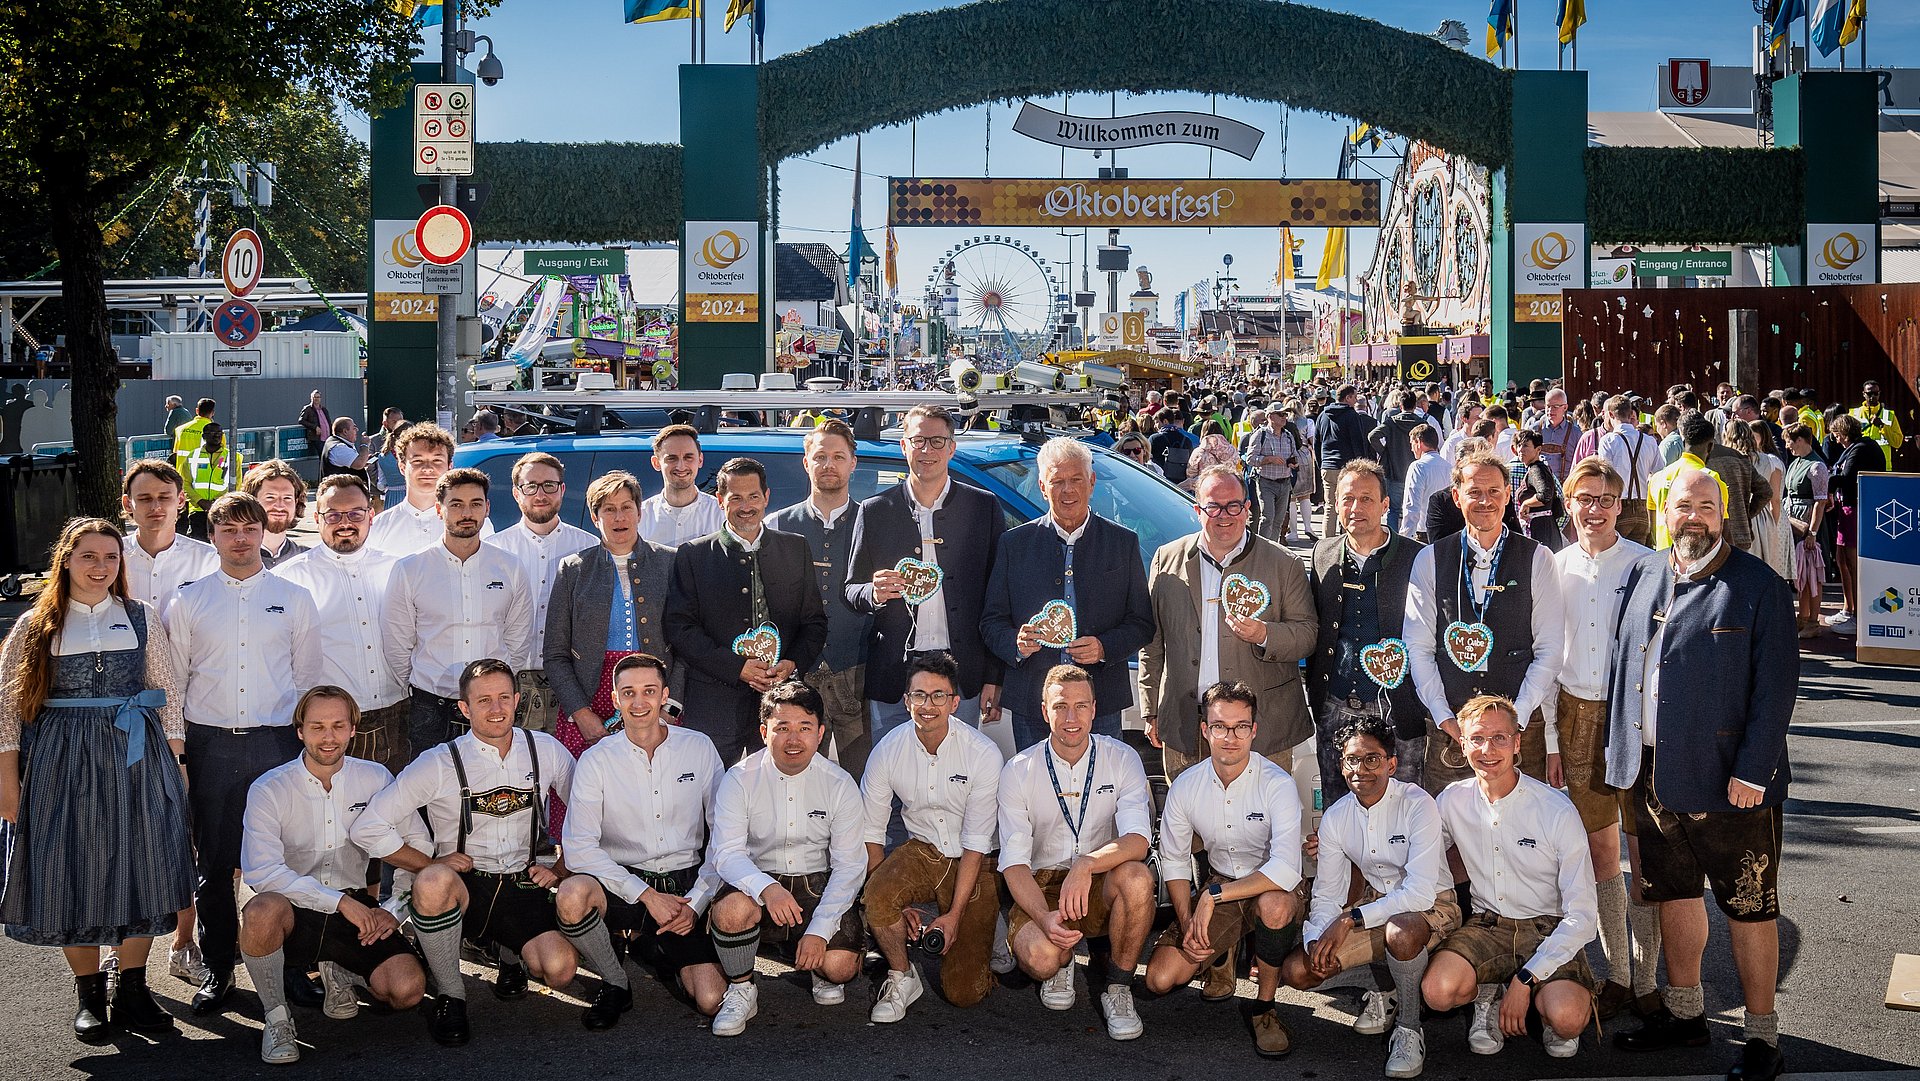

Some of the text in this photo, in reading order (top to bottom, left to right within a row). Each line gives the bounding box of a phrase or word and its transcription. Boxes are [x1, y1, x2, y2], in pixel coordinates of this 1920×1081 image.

[1057, 120, 1220, 143] Willkommen zum
[1038, 183, 1235, 223] Oktoberfest
[234, 248, 253, 279] 10
[537, 258, 609, 270] Ausgang / Exit
[1639, 259, 1728, 271] Eingang / Entrance
[427, 268, 449, 276] Fahrzeug
[697, 271, 745, 281] Oktoberfest
[1526, 272, 1572, 282] Oktoberfest
[1818, 272, 1863, 282] Oktoberfest
[1232, 296, 1282, 304] vinzenzmur
[390, 299, 436, 315] 2024
[701, 300, 746, 316] 2024
[1529, 300, 1562, 316] 202
[216, 359, 258, 369] Rettungsweg
[1146, 355, 1194, 373] Information
[904, 570, 914, 579] M
[904, 583, 925, 596] TUM
[1230, 586, 1241, 597] M
[1228, 602, 1250, 616] TUM
[1040, 625, 1051, 636] M
[1051, 625, 1073, 642] TUM
[1455, 637, 1465, 646] M
[744, 646, 755, 657] M
[757, 651, 775, 663] UM
[1456, 651, 1477, 661] TUM
[1371, 655, 1383, 669] M
[1376, 667, 1400, 682] TUM
